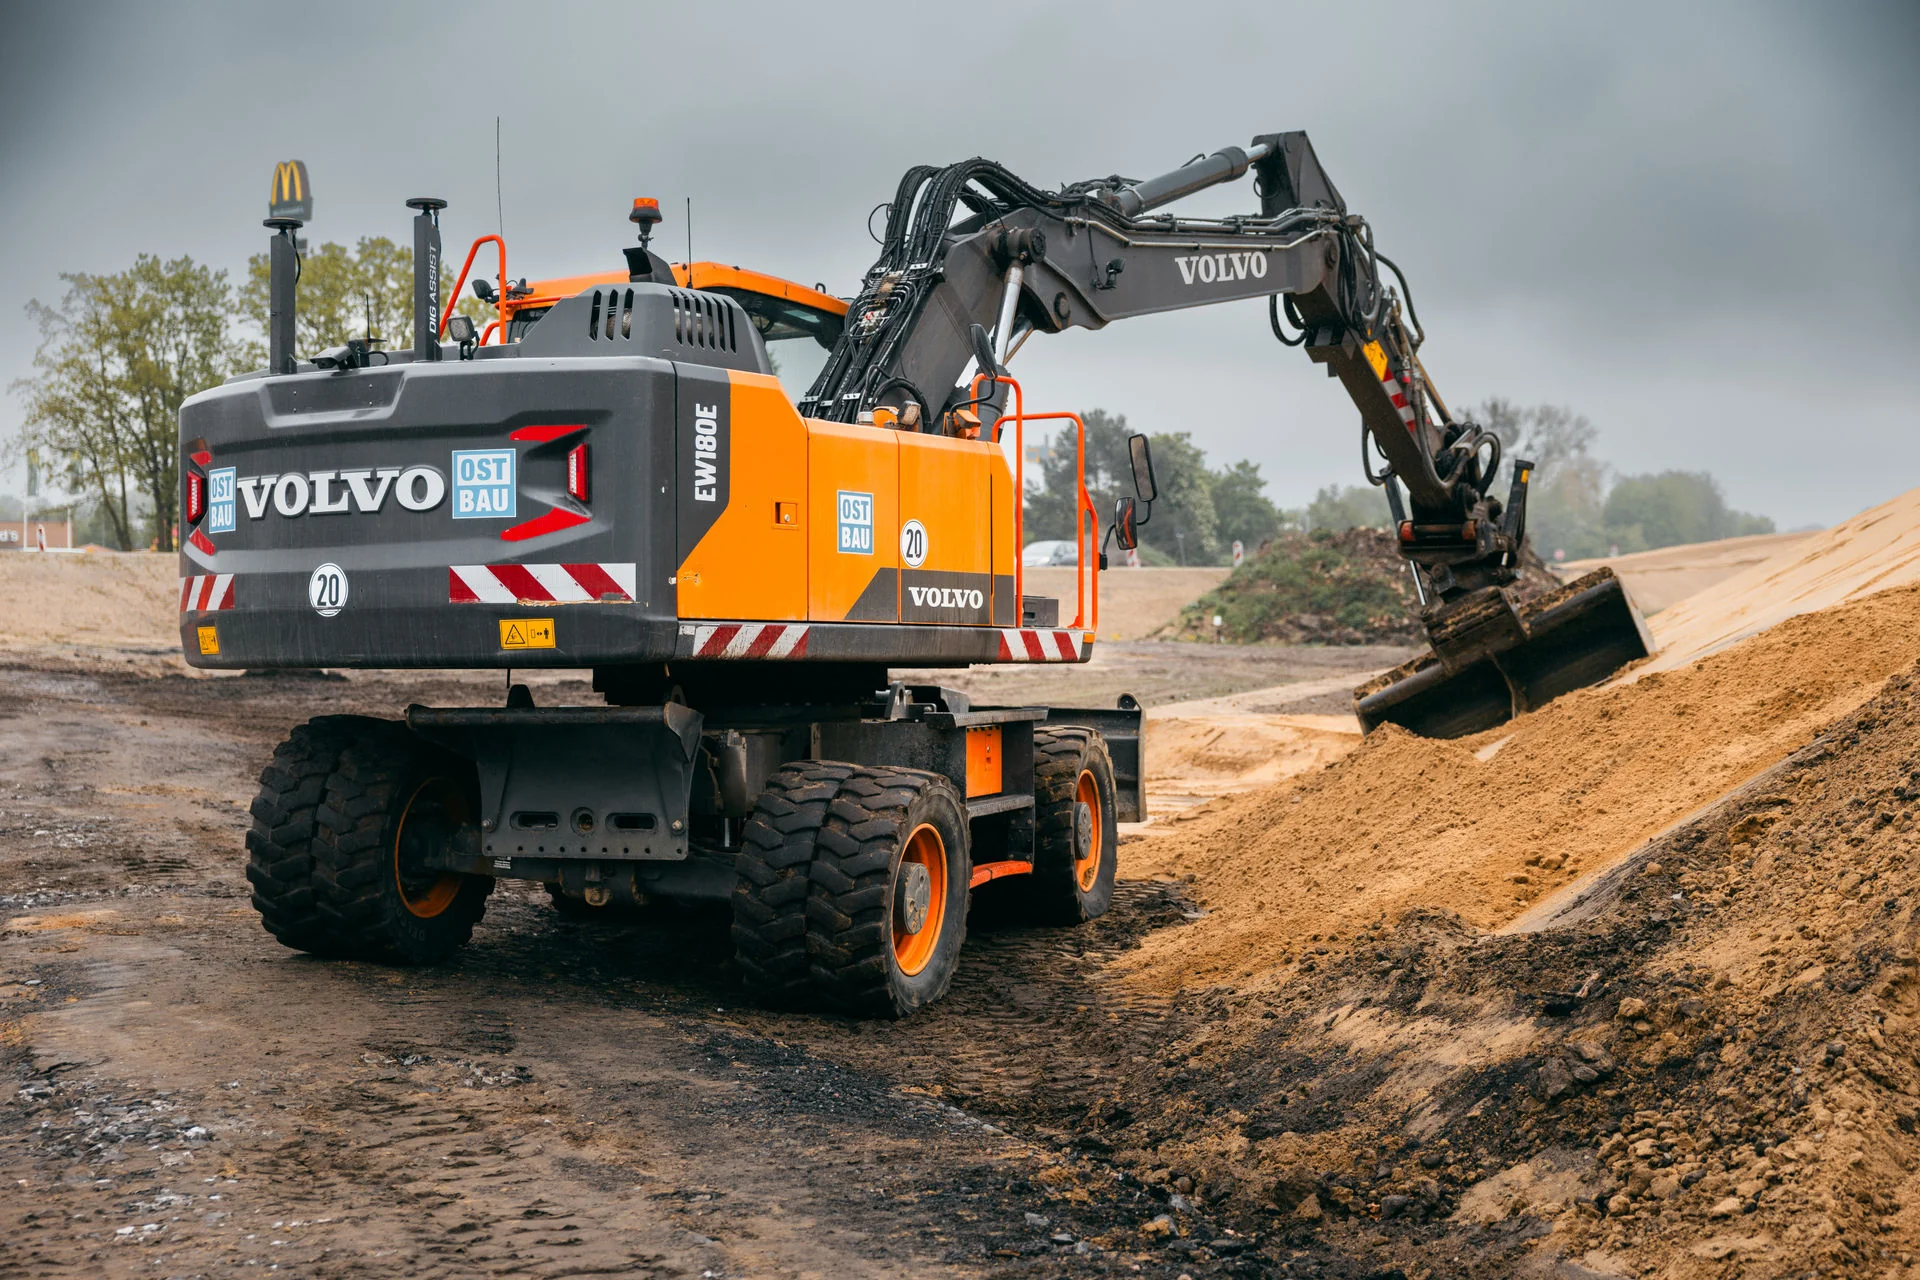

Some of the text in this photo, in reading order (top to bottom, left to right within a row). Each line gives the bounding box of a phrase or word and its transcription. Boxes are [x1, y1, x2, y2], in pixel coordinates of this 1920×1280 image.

[1174, 251, 1268, 284] VOLVO
[429, 242, 437, 334] DIG ASSIST
[694, 403, 717, 502] EW180E
[461, 457, 508, 481] OST
[211, 476, 232, 498] OST
[237, 466, 446, 519] VOLVO
[459, 488, 509, 513] BAU
[842, 498, 869, 521] OST
[211, 504, 232, 528] BAU
[841, 526, 870, 550] BAU
[905, 528, 922, 559] 20
[316, 573, 340, 606] 20
[908, 586, 984, 609] VOLVO
